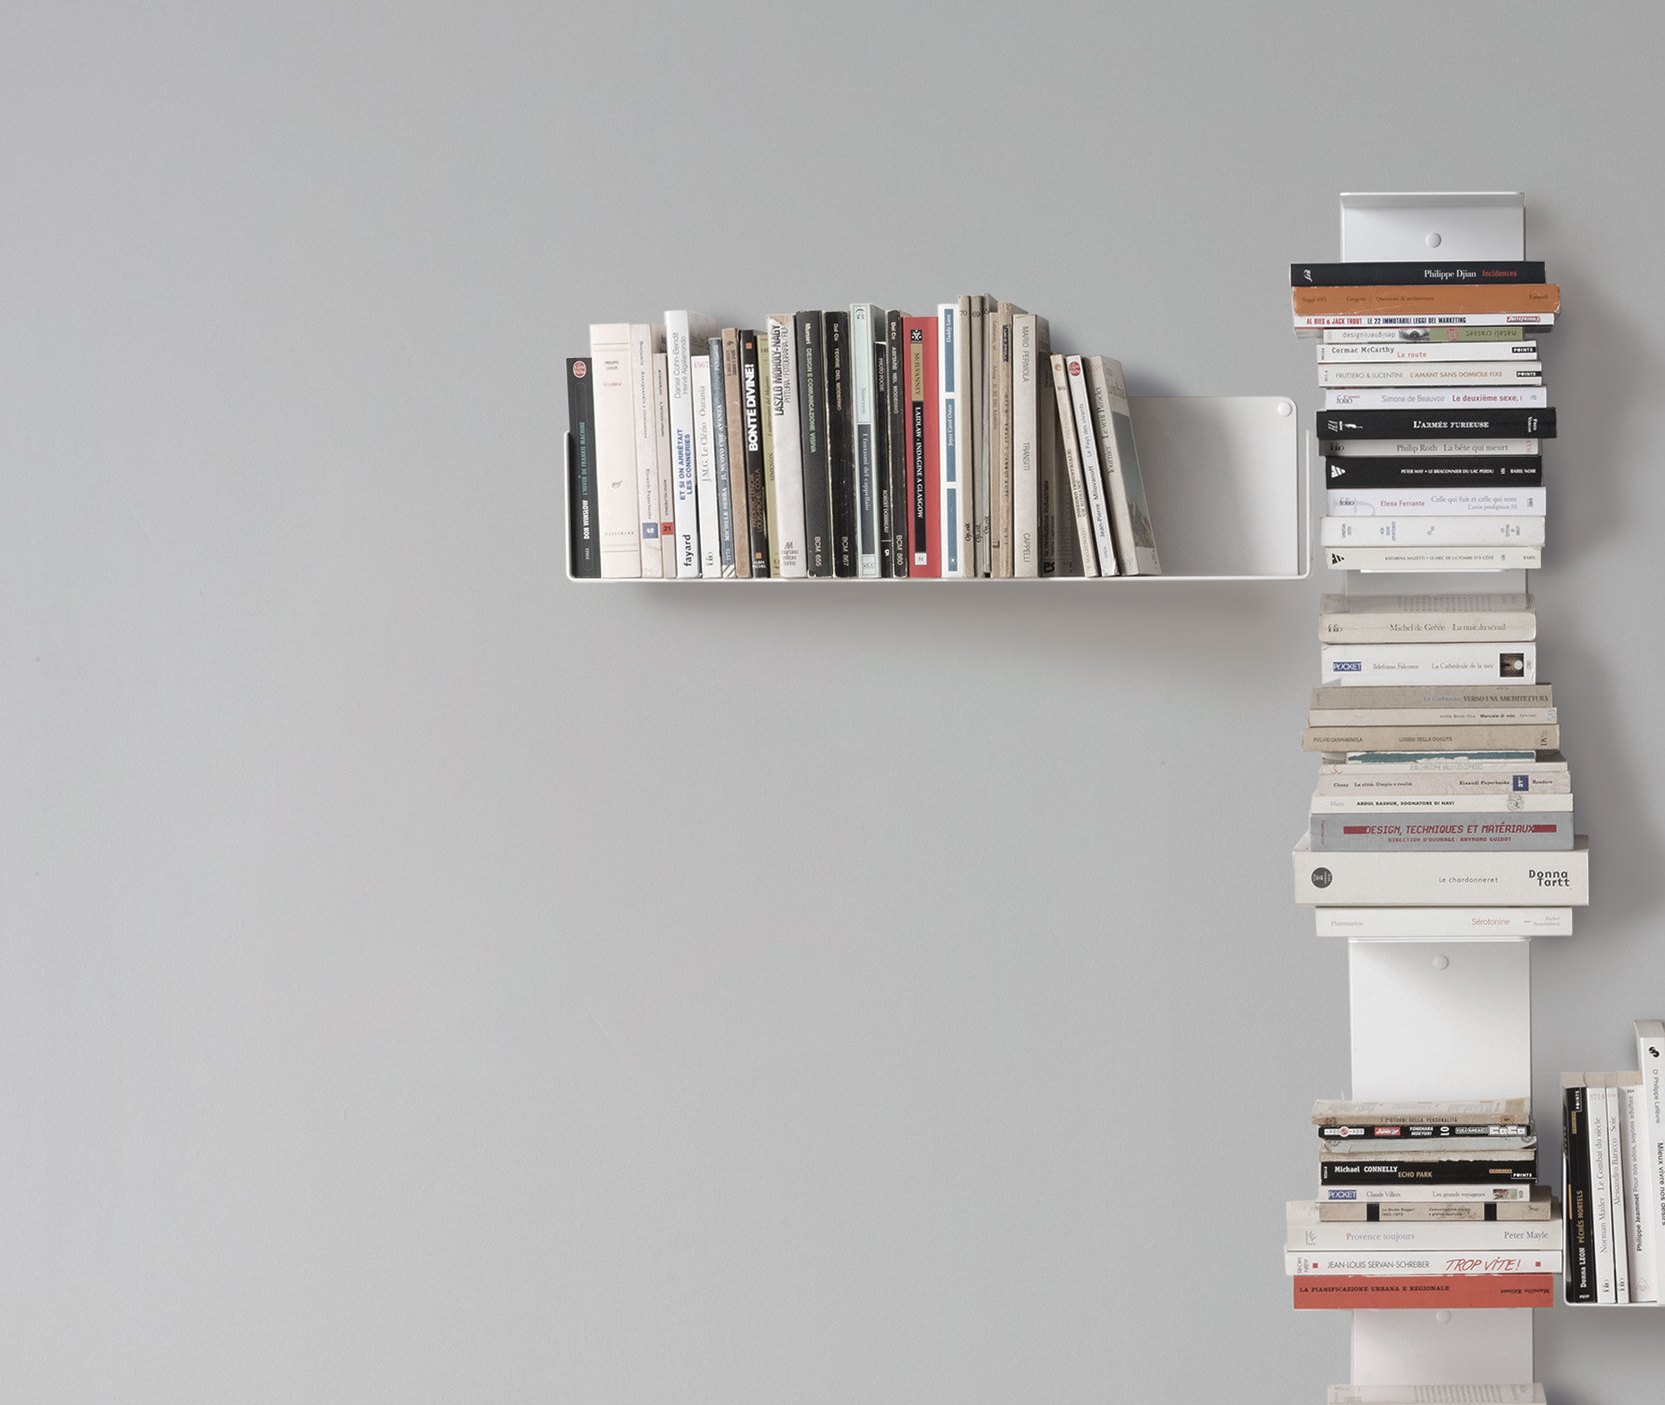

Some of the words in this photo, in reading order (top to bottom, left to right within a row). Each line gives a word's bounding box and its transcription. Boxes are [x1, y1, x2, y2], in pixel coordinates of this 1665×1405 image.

[1424, 269, 1454, 280] Philippe
[1456, 269, 1477, 278] Djian
[1373, 317, 1381, 325] 22
[1412, 317, 1427, 325] LEGGI
[1437, 316, 1467, 324] MARKETING
[1021, 326, 1030, 348] MARIO
[1021, 350, 1030, 383] PERNIOLA
[673, 378, 682, 399] Daniel
[744, 364, 757, 407] DIVINE!
[700, 447, 709, 457] Le
[1396, 443, 1416, 453] Philip
[1419, 443, 1438, 452] Roth
[1443, 443, 1454, 452] La
[684, 433, 692, 479] CONNERIES
[1022, 442, 1031, 471] TRANSITI
[678, 467, 685, 479] ON
[679, 490, 686, 500] ET
[916, 484, 924, 518] GLASGOW
[582, 500, 590, 526] WINSLOW
[683, 534, 692, 567] fayard
[1023, 532, 1031, 563] CAPPELLI
[1366, 825, 1403, 835] DESIGN,
[1406, 824, 1464, 835] TECHNIQUES
[1467, 824, 1478, 834] ET
[1528, 870, 1568, 879] Donna
[1537, 877, 1570, 887] Tartt
[1471, 917, 1510, 927] Sérotonine
[1594, 1139, 1603, 1150] du
[1334, 1165, 1360, 1173] Michael
[1363, 1165, 1398, 1173] CONNELLY
[1596, 1151, 1604, 1180] Combat
[1596, 1181, 1605, 1191] Le
[1328, 1189, 1357, 1199] POCKET
[1632, 1193, 1641, 1223] Jeammet
[1346, 1232, 1381, 1241] Provence
[1382, 1233, 1415, 1241] toujours
[1504, 1231, 1524, 1240] Peter
[1526, 1231, 1548, 1239] Mayle
[1599, 1222, 1608, 1254] Norman
[1633, 1223, 1643, 1252] Philippe
[1445, 1259, 1481, 1272] TROP
